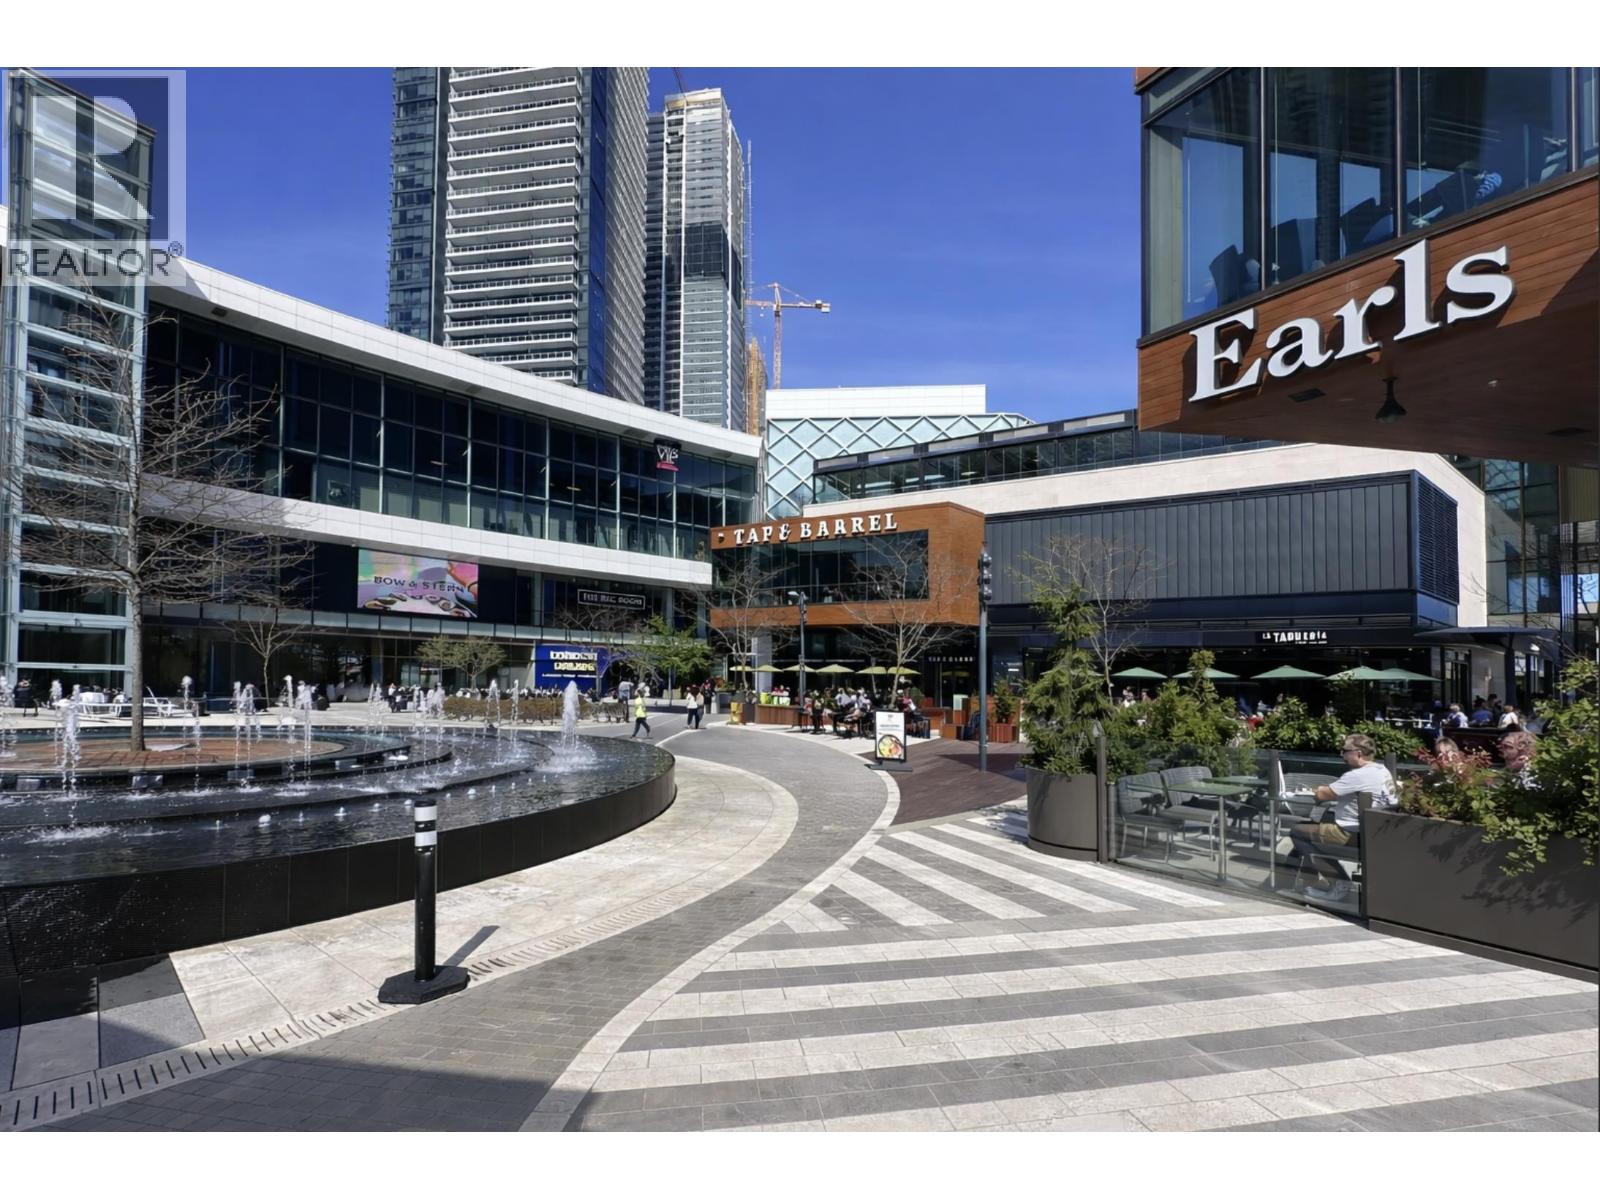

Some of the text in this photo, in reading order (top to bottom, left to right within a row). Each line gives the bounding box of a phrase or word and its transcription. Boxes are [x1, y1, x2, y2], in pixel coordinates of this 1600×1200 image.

[1188, 238, 1516, 403] Earls
[734, 512, 898, 545] TAP & BARREL
[373, 576, 405, 587] BOW
[422, 581, 465, 593] STERN
